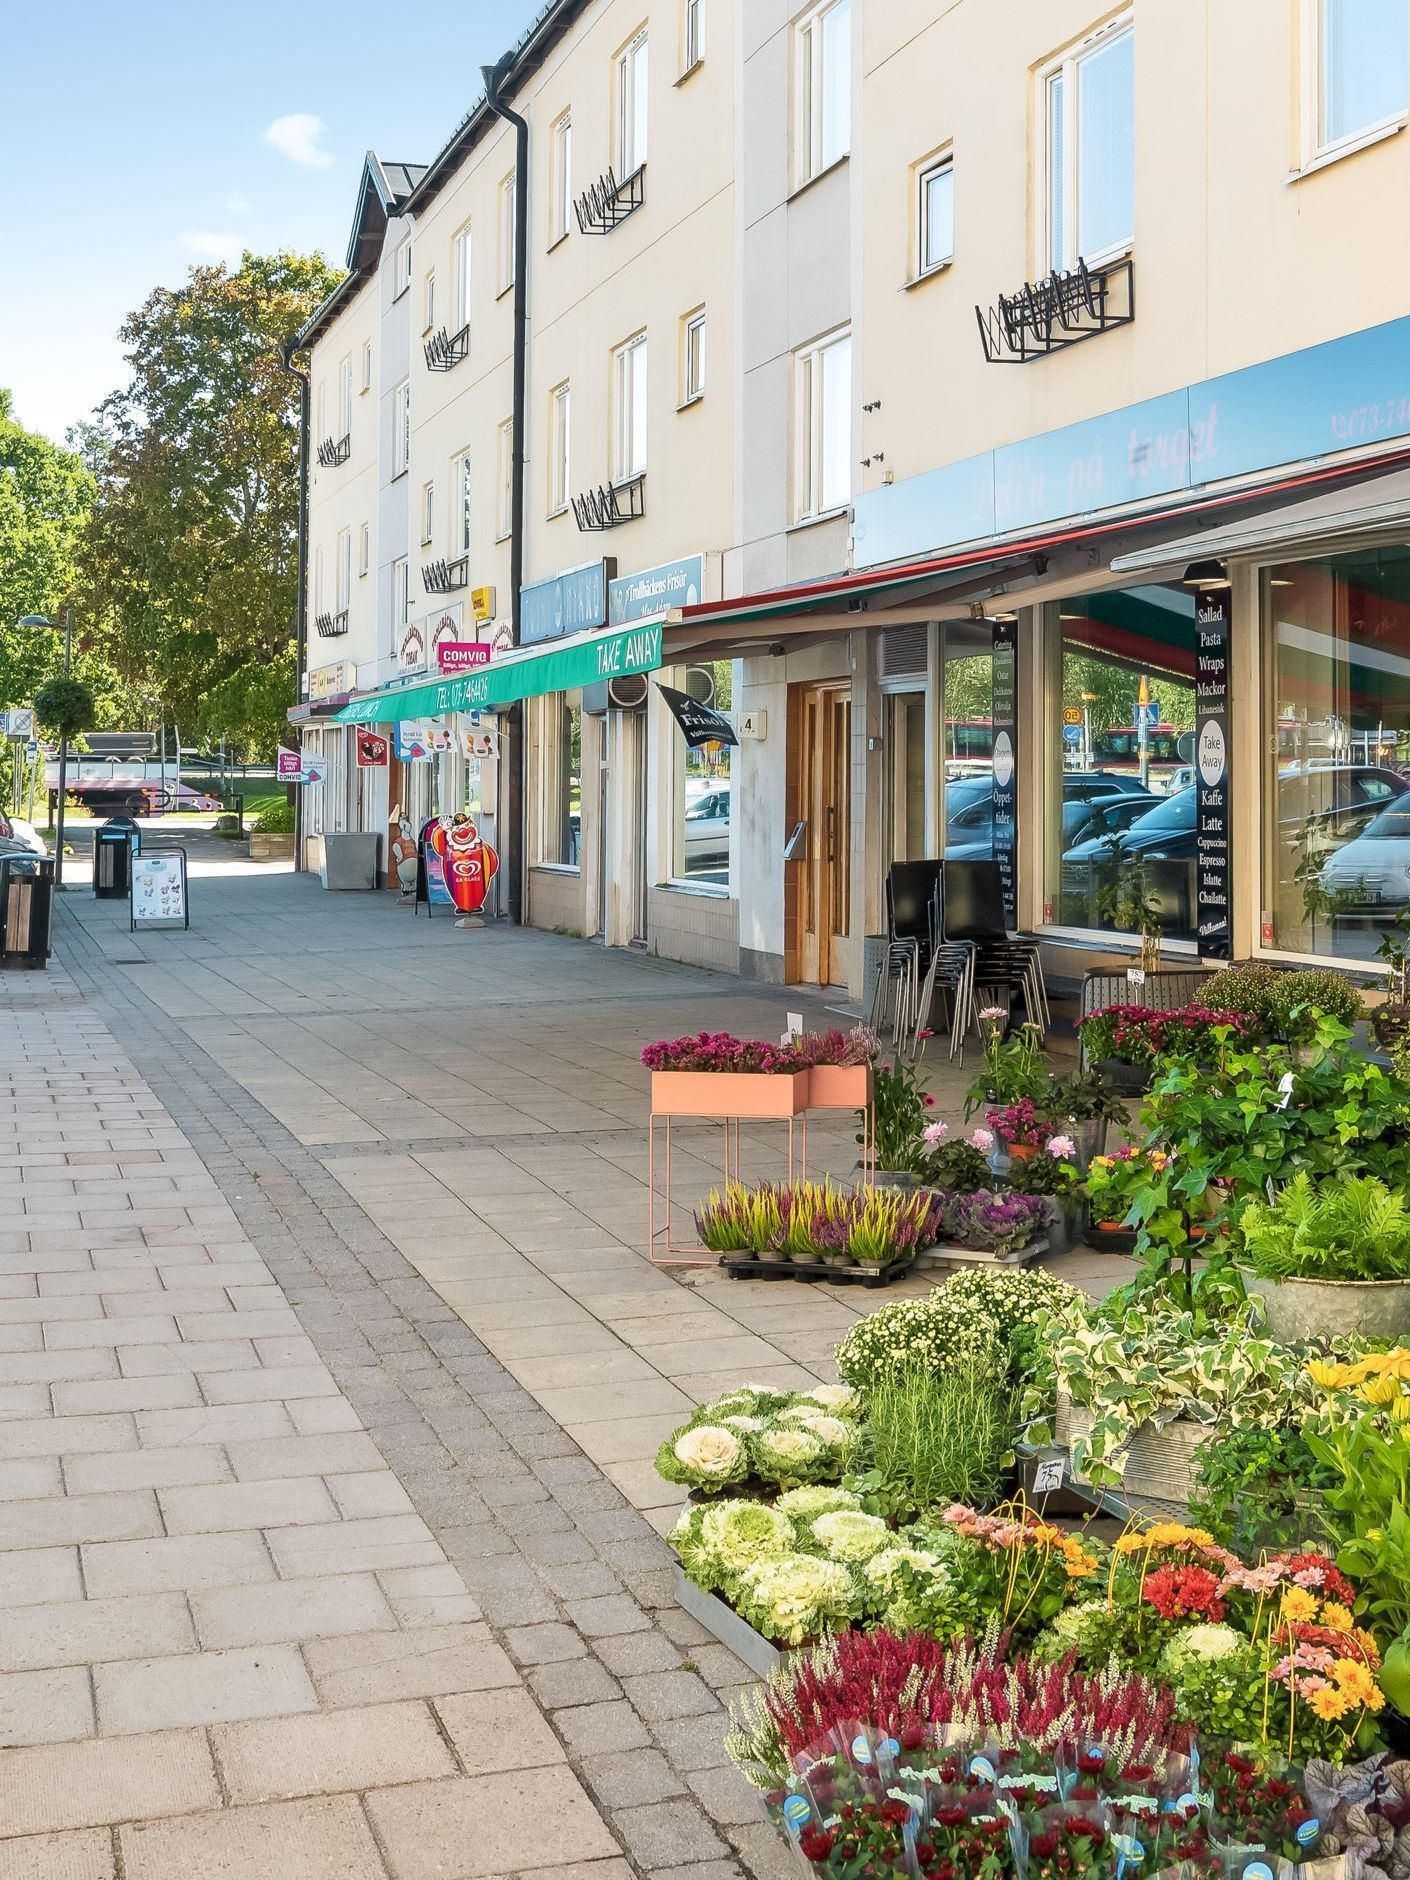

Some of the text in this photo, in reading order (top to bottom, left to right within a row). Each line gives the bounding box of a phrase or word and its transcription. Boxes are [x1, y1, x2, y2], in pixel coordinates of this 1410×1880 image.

[667, 568, 688, 591] Frisör
[1198, 605, 1222, 624] Sallad
[1200, 632, 1221, 648] Pasta
[443, 650, 487, 662] COMVIQ
[597, 628, 659, 675] TAKE AWAY
[1198, 655, 1224, 675] Wraps
[1197, 680, 1226, 697] Mackor
[436, 687, 450, 710] TEL:
[1198, 703, 1225, 715] Libanesisk
[680, 713, 726, 727] Frisör
[744, 718, 752, 729] 4
[1203, 736, 1221, 750] Take
[1201, 754, 1223, 771] Away
[993, 788, 1012, 807] Öppet-
[1201, 789, 1223, 806] Kaffe
[995, 810, 1010, 824] tider
[1201, 815, 1223, 831] Latte
[1197, 836, 1227, 850] Cappuccino
[1199, 853, 1226, 869] Espresso
[1203, 873, 1222, 886] Islatte
[1199, 891, 1227, 905] Chailatte
